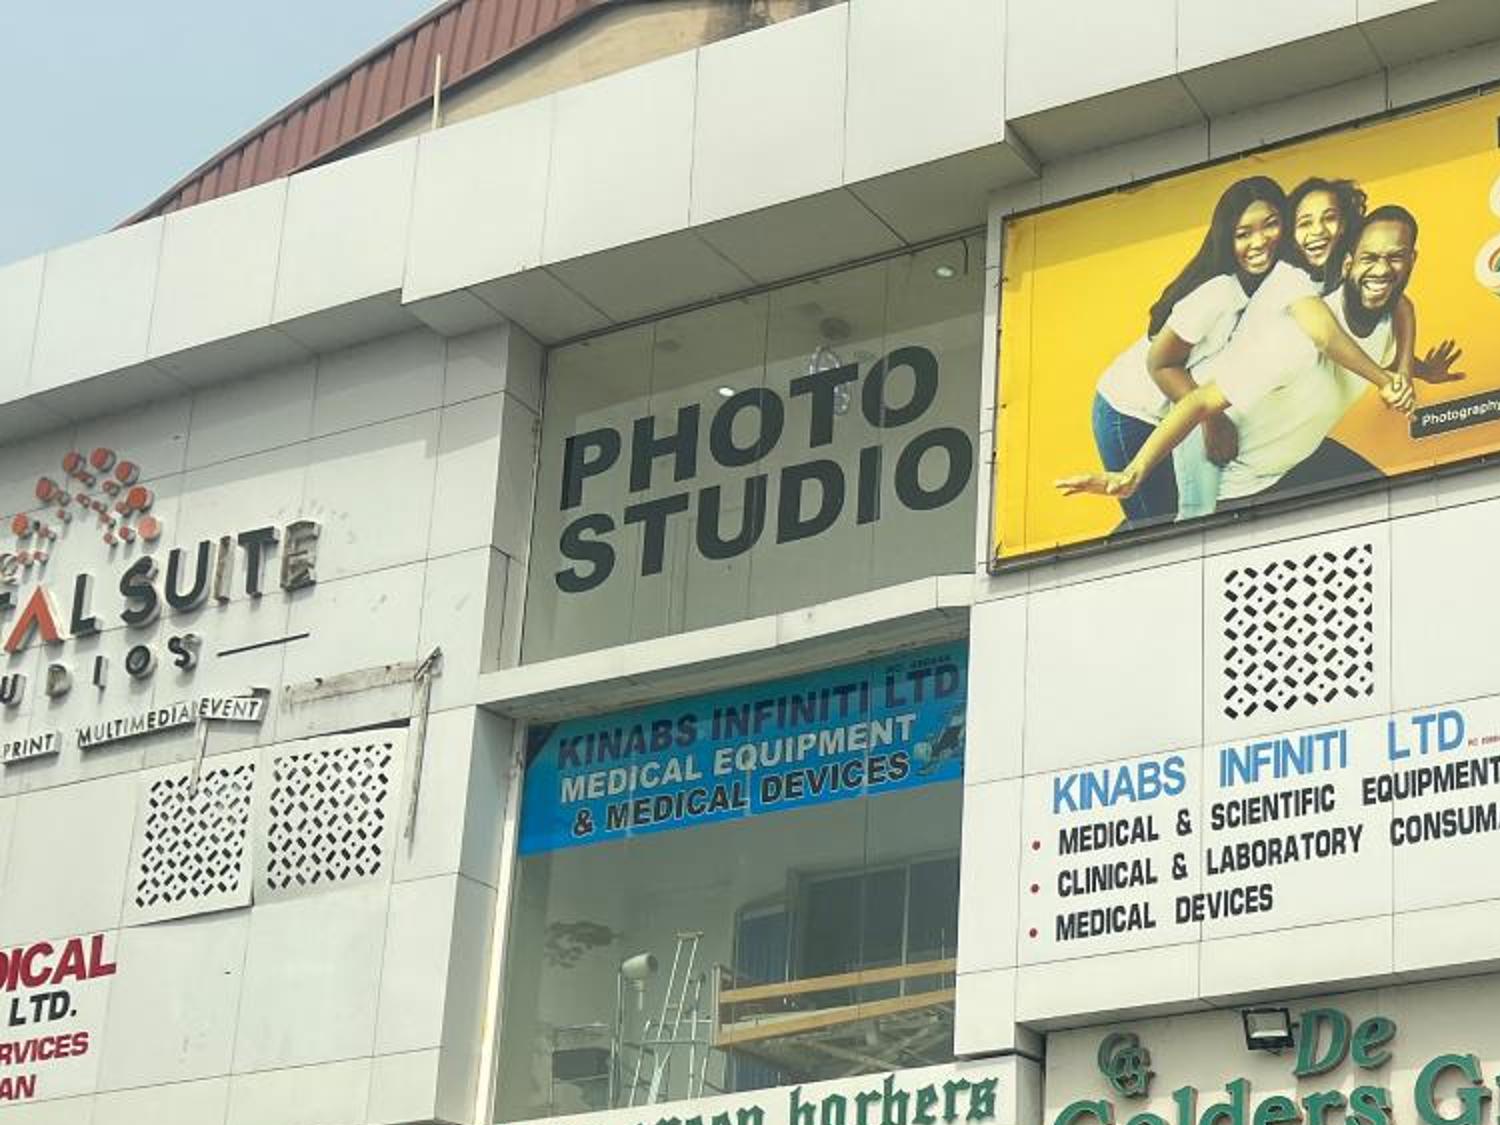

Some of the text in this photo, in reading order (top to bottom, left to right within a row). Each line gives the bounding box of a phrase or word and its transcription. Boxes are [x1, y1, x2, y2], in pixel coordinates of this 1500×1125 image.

[560, 345, 938, 510] PHOTO
[555, 426, 973, 593] STUDIO
[78, 704, 191, 746] MULTIMEDIA
[199, 697, 260, 718] EVENT
[558, 664, 960, 769] KINABS INFINITI LTD
[560, 713, 918, 802] MEDICAL EQUIPMENT
[572, 750, 911, 837] & MEDICAL DEVICES
[1052, 709, 1466, 815] KINABS INFINITI LTD
[1058, 814, 1160, 856] MEDICAL
[1176, 808, 1192, 836] &
[1210, 783, 1336, 832] SCIENTIFIC
[1057, 858, 1159, 898] CLINICAL
[1172, 853, 1188, 880] &
[1206, 824, 1364, 877] LABORATORY
[1055, 883, 1274, 942] MEDICAL DEVICES
[8, 989, 78, 1027] LTD.
[1294, 1006, 1397, 1078] De
